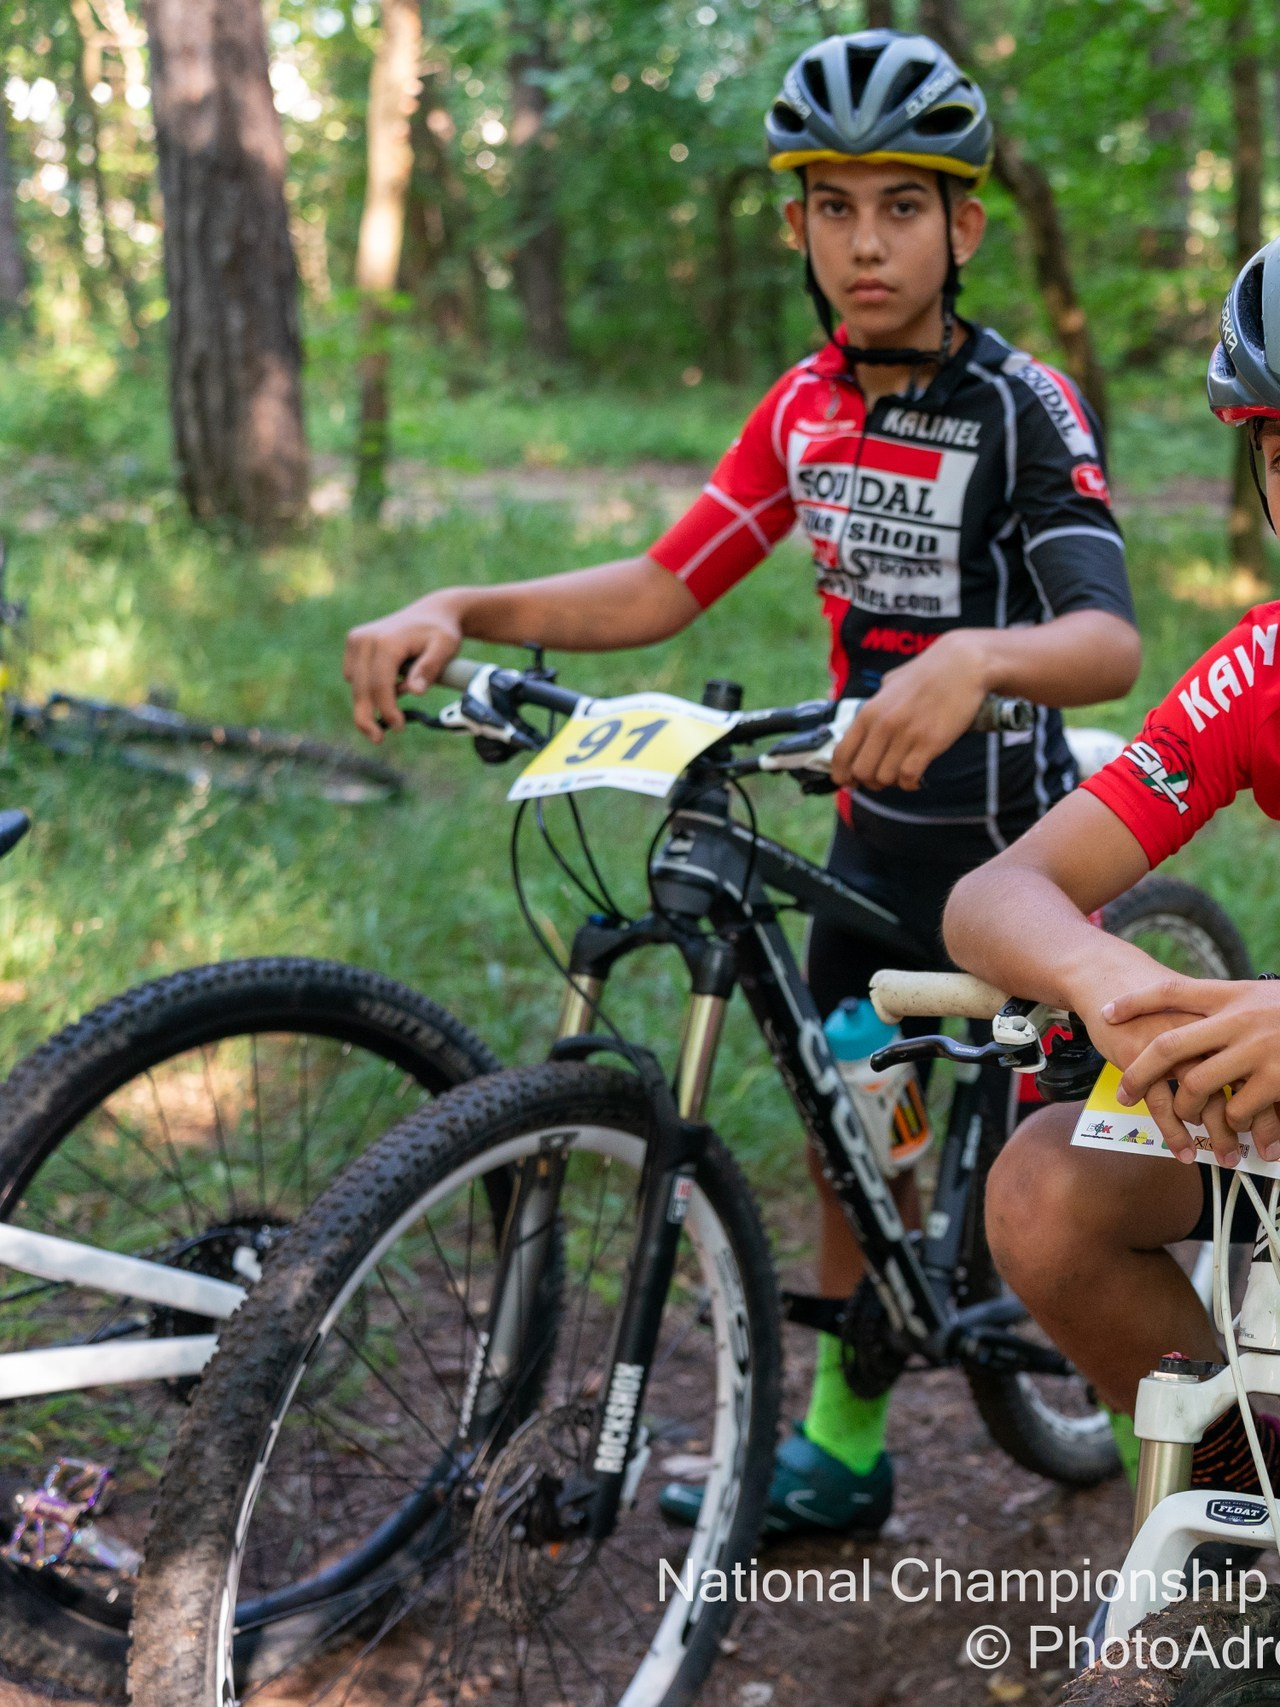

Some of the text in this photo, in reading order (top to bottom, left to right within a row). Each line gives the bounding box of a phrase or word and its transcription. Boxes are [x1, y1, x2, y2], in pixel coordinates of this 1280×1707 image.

[881, 406, 982, 448] KALINEL
[565, 718, 671, 766] 91
[594, 1362, 645, 1473] ROCKSHOX
[1218, 1505, 1260, 1517] FLOAT
